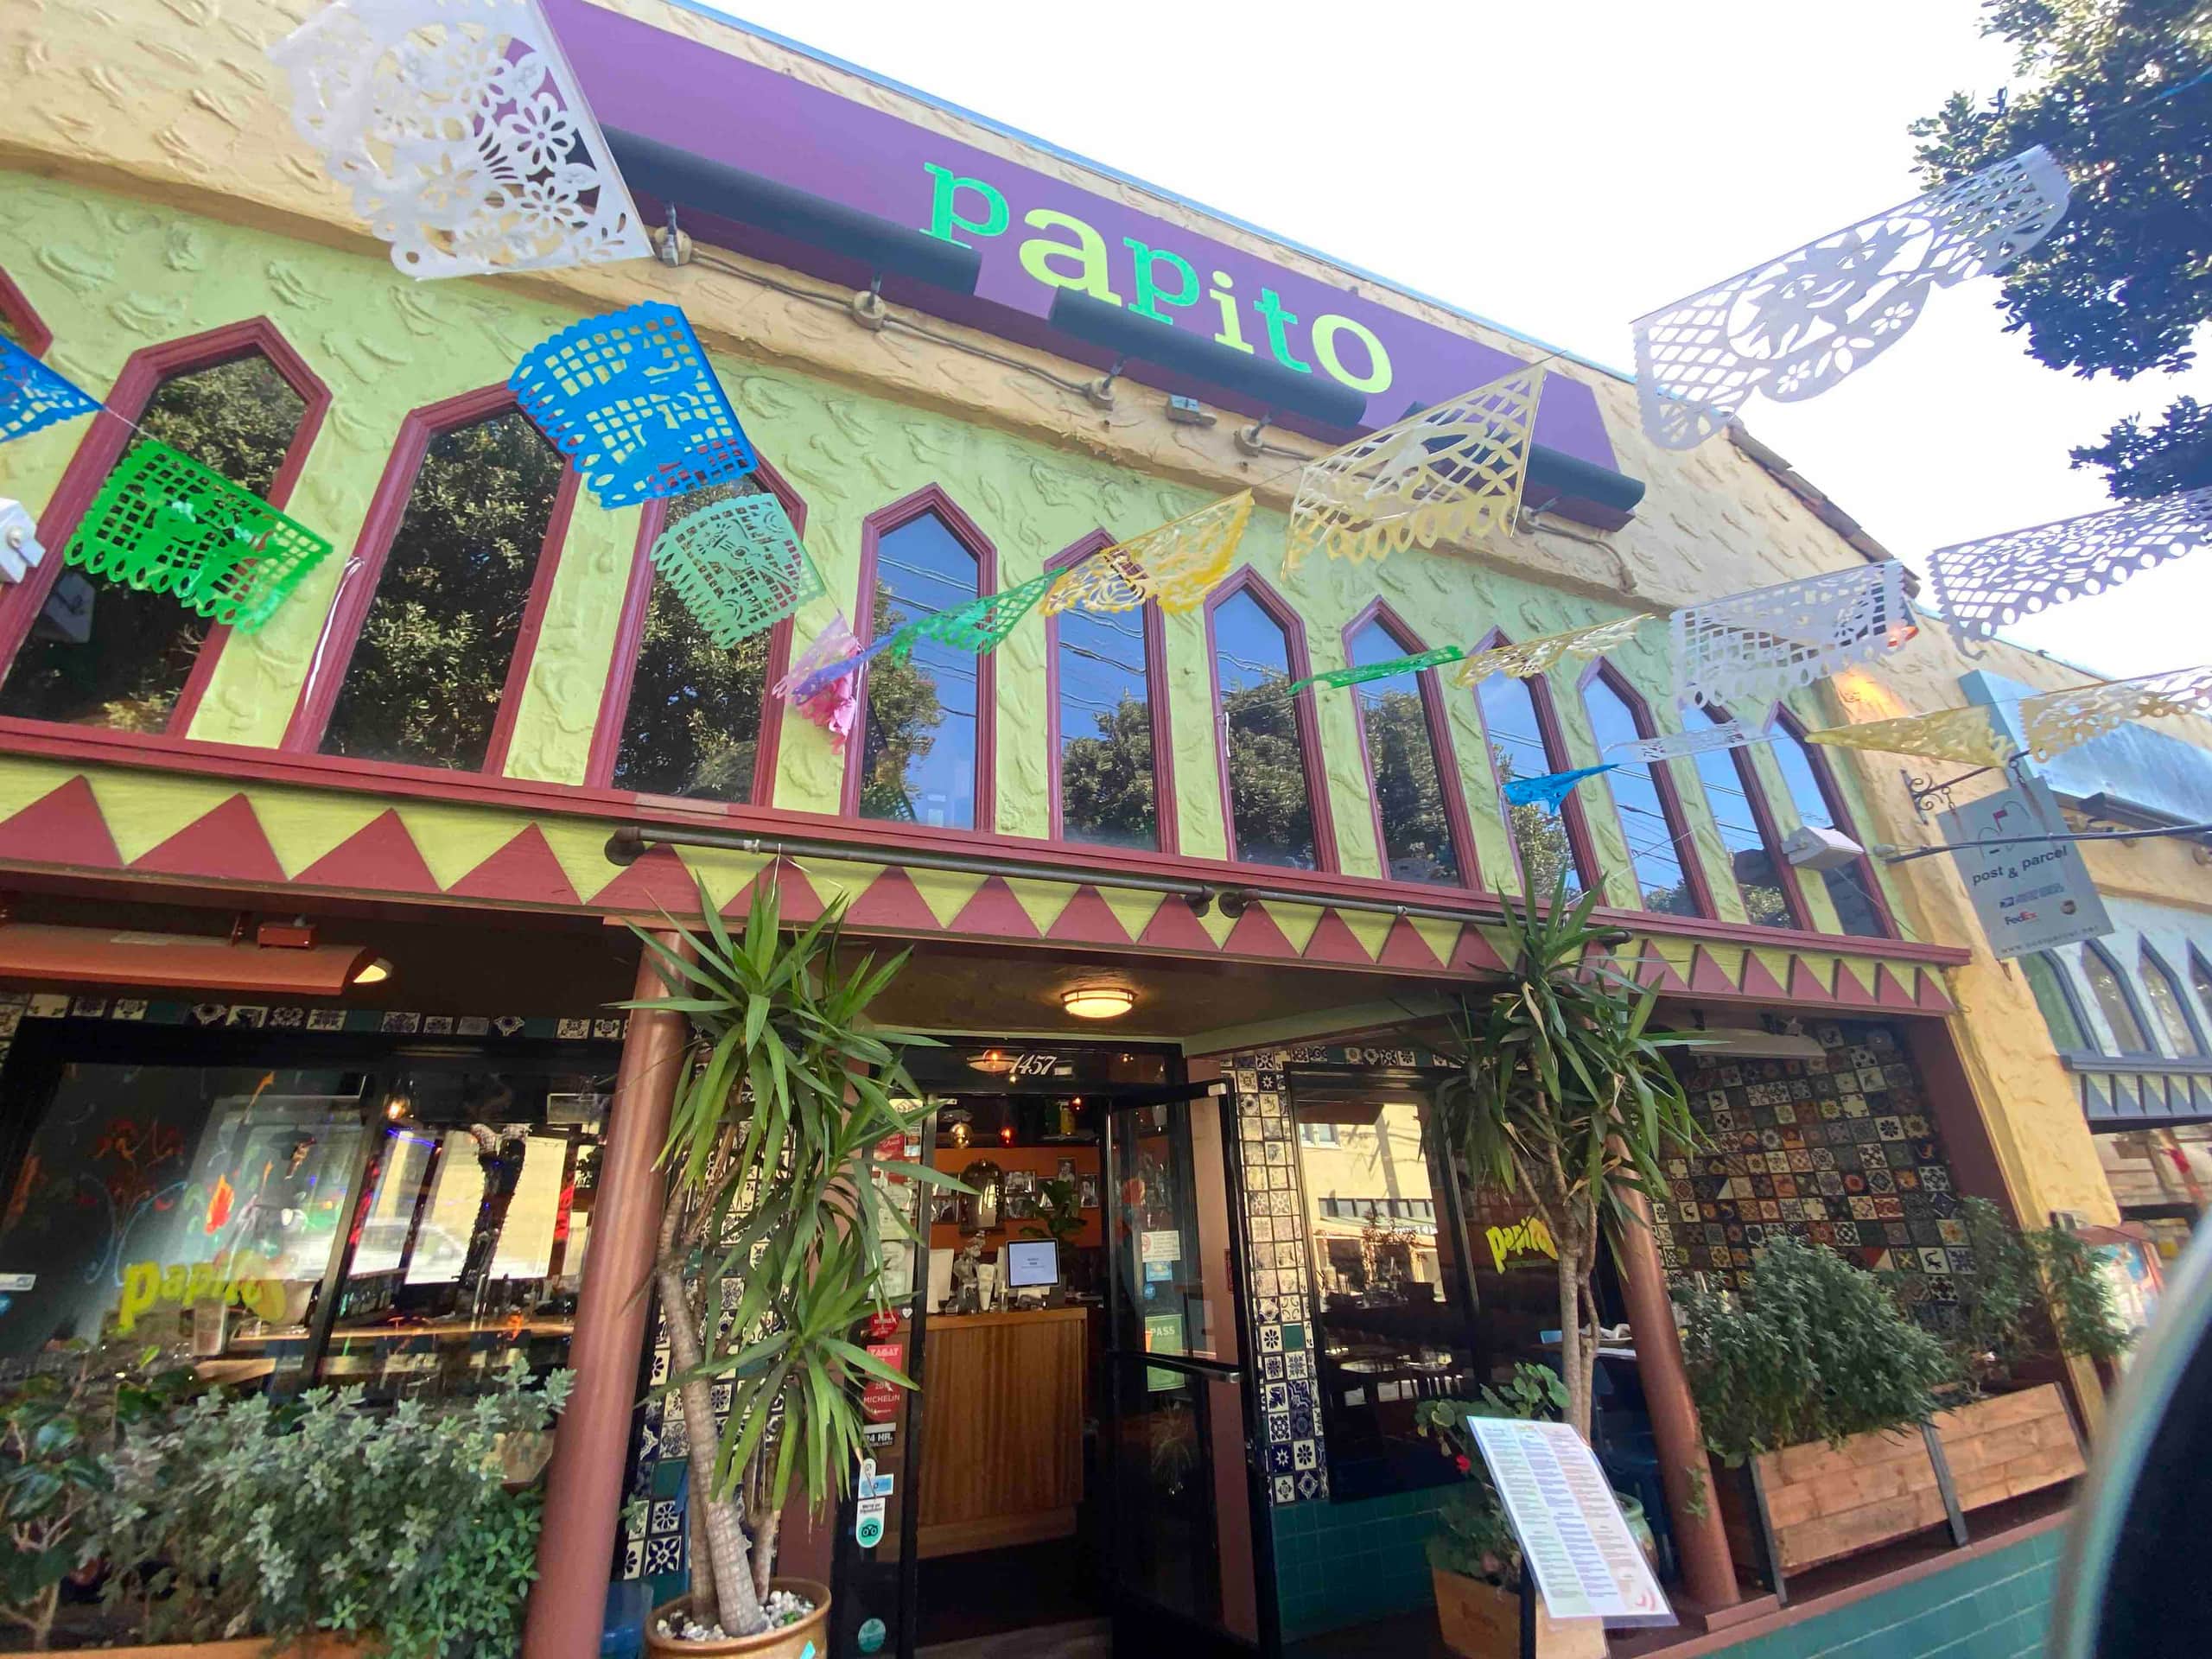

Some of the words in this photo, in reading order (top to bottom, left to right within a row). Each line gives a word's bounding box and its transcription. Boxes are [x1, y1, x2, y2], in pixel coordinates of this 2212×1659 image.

[918, 162, 1392, 394] papito
[1972, 866, 2004, 887] post
[2008, 867, 2018, 879] &
[2022, 845, 2068, 871] parcel
[2005, 911, 2037, 925] FedEx
[1009, 1053, 1057, 1075] 1457
[1151, 1325, 1176, 1337] PASS
[863, 1394, 900, 1404] MICHELIN
